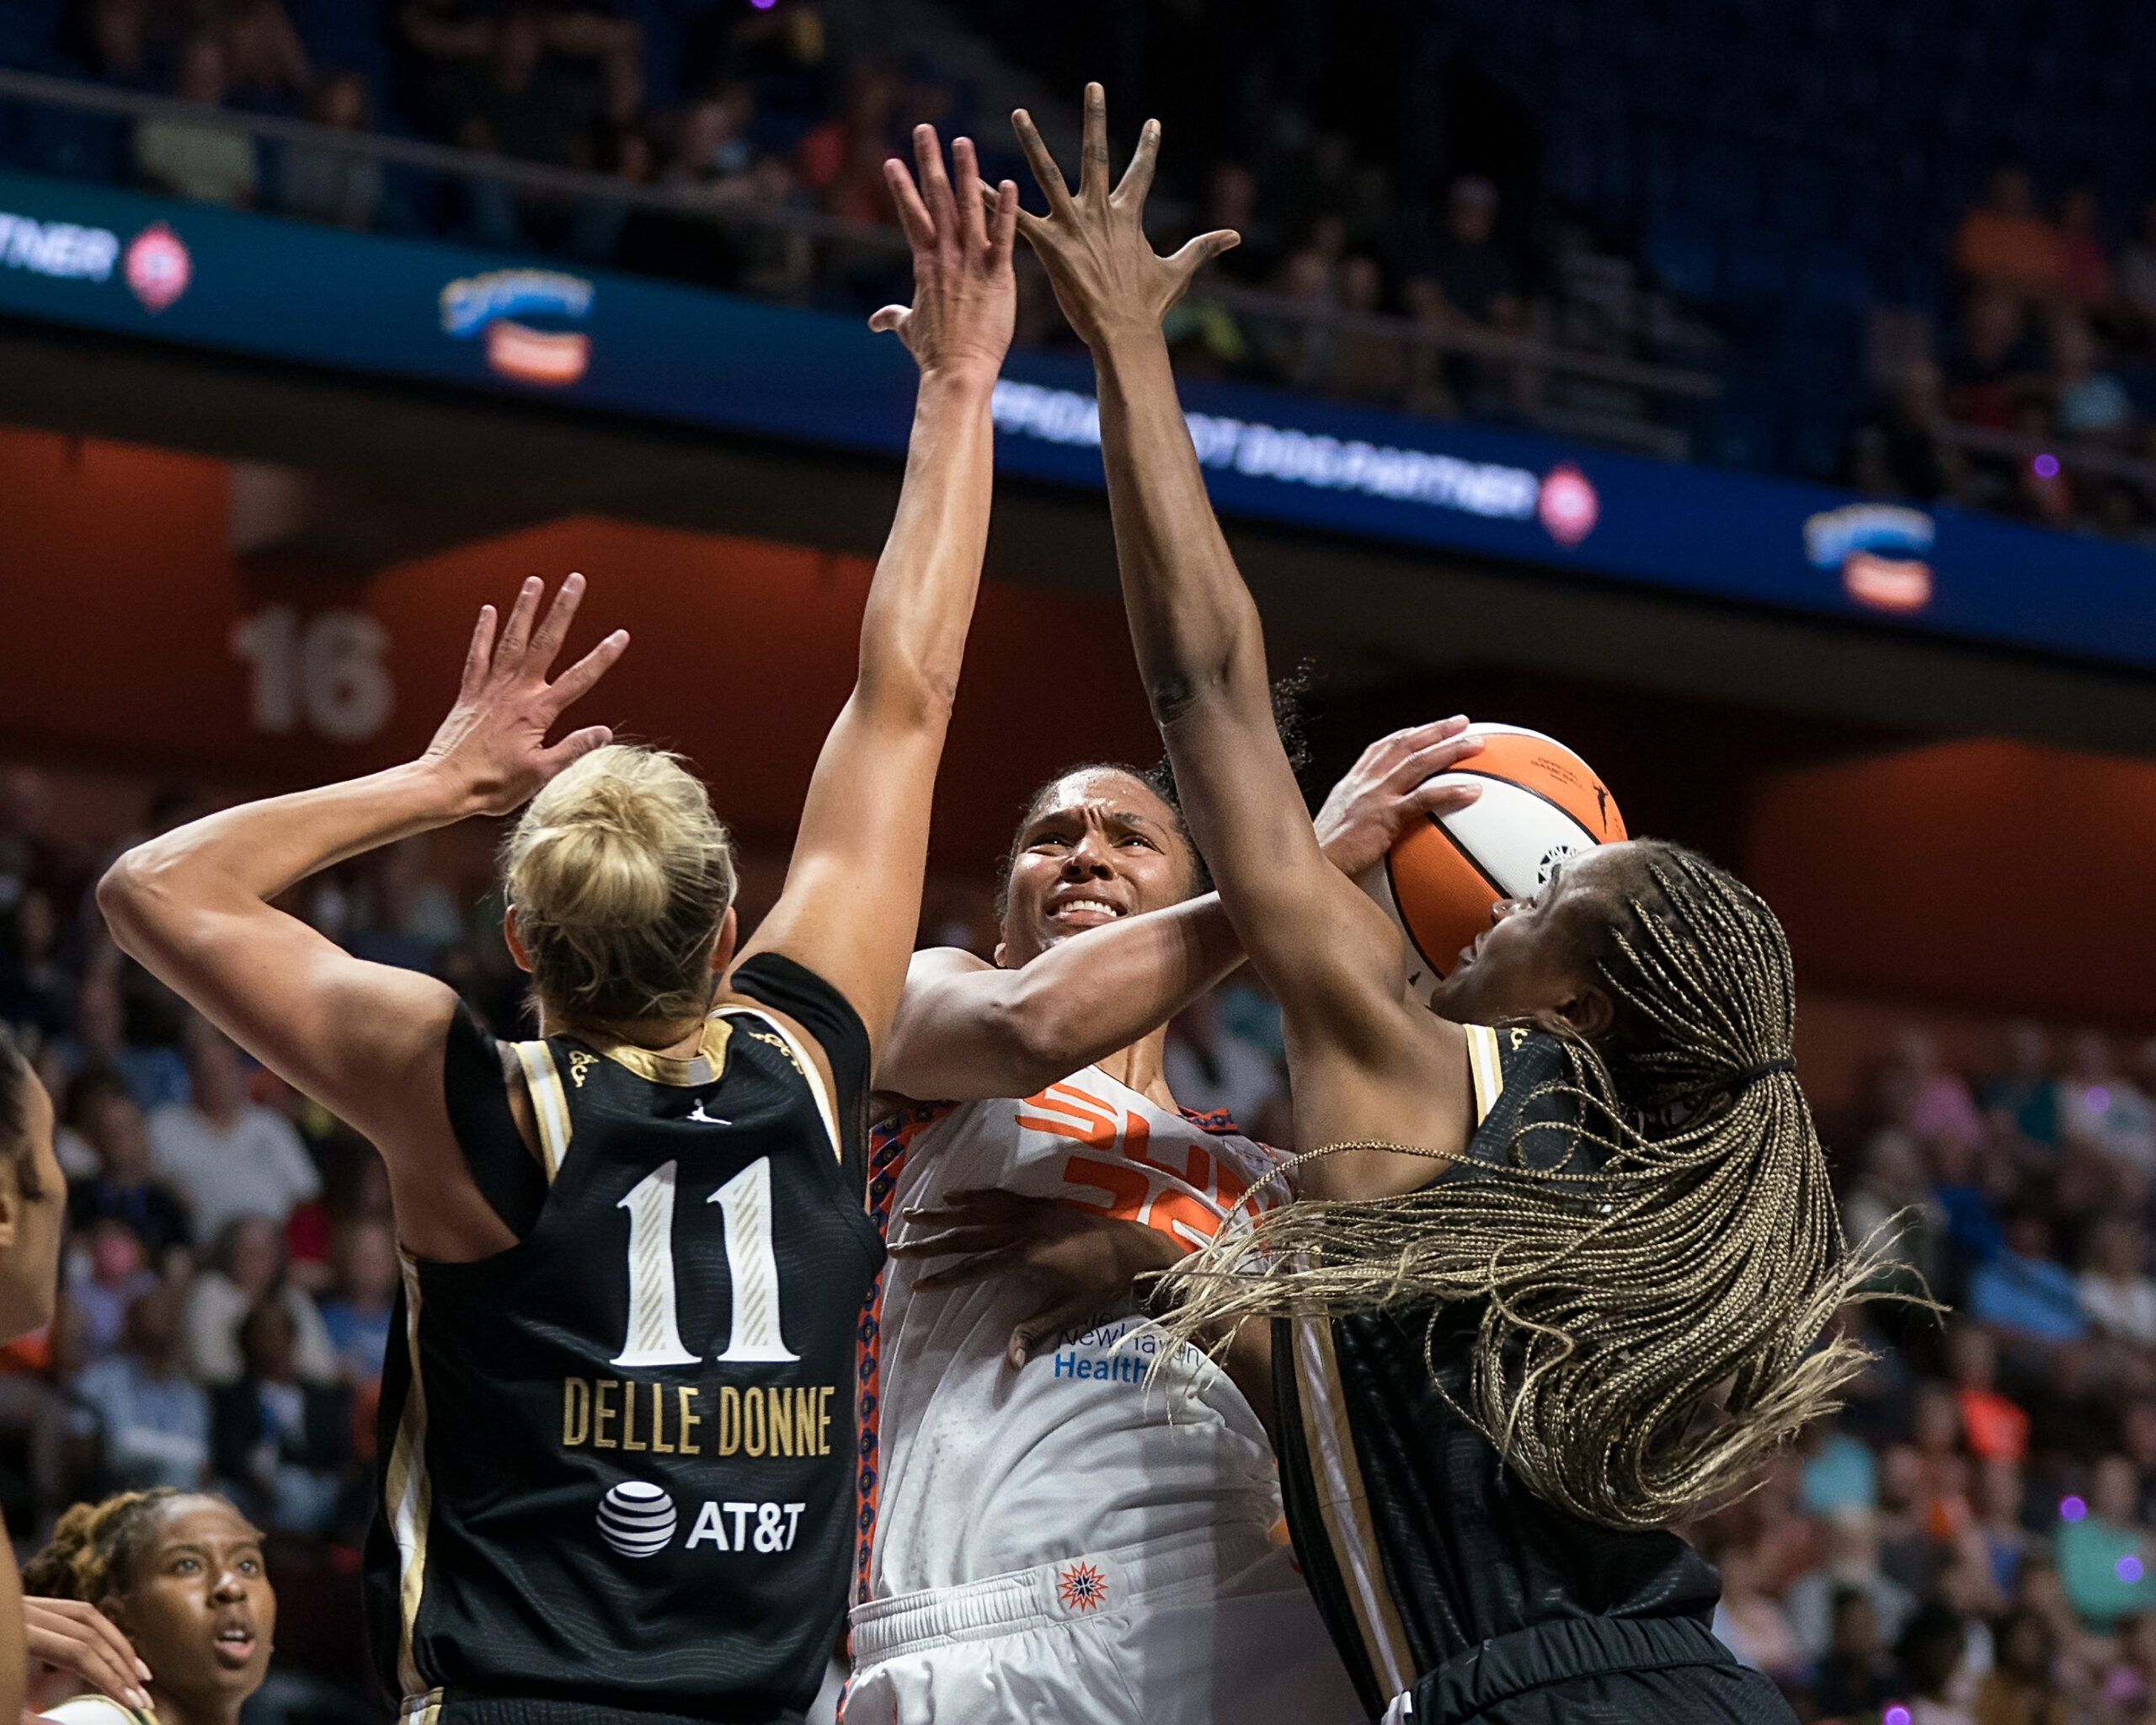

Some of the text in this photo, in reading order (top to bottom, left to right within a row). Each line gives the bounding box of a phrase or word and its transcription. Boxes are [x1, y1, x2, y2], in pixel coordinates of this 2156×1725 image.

[231, 604, 394, 742] 16
[609, 1156, 801, 1366] 11
[1055, 1351, 1147, 1384] Health
[563, 1378, 835, 1457] DELLE DONNE
[686, 1502, 806, 1552] AT&T
